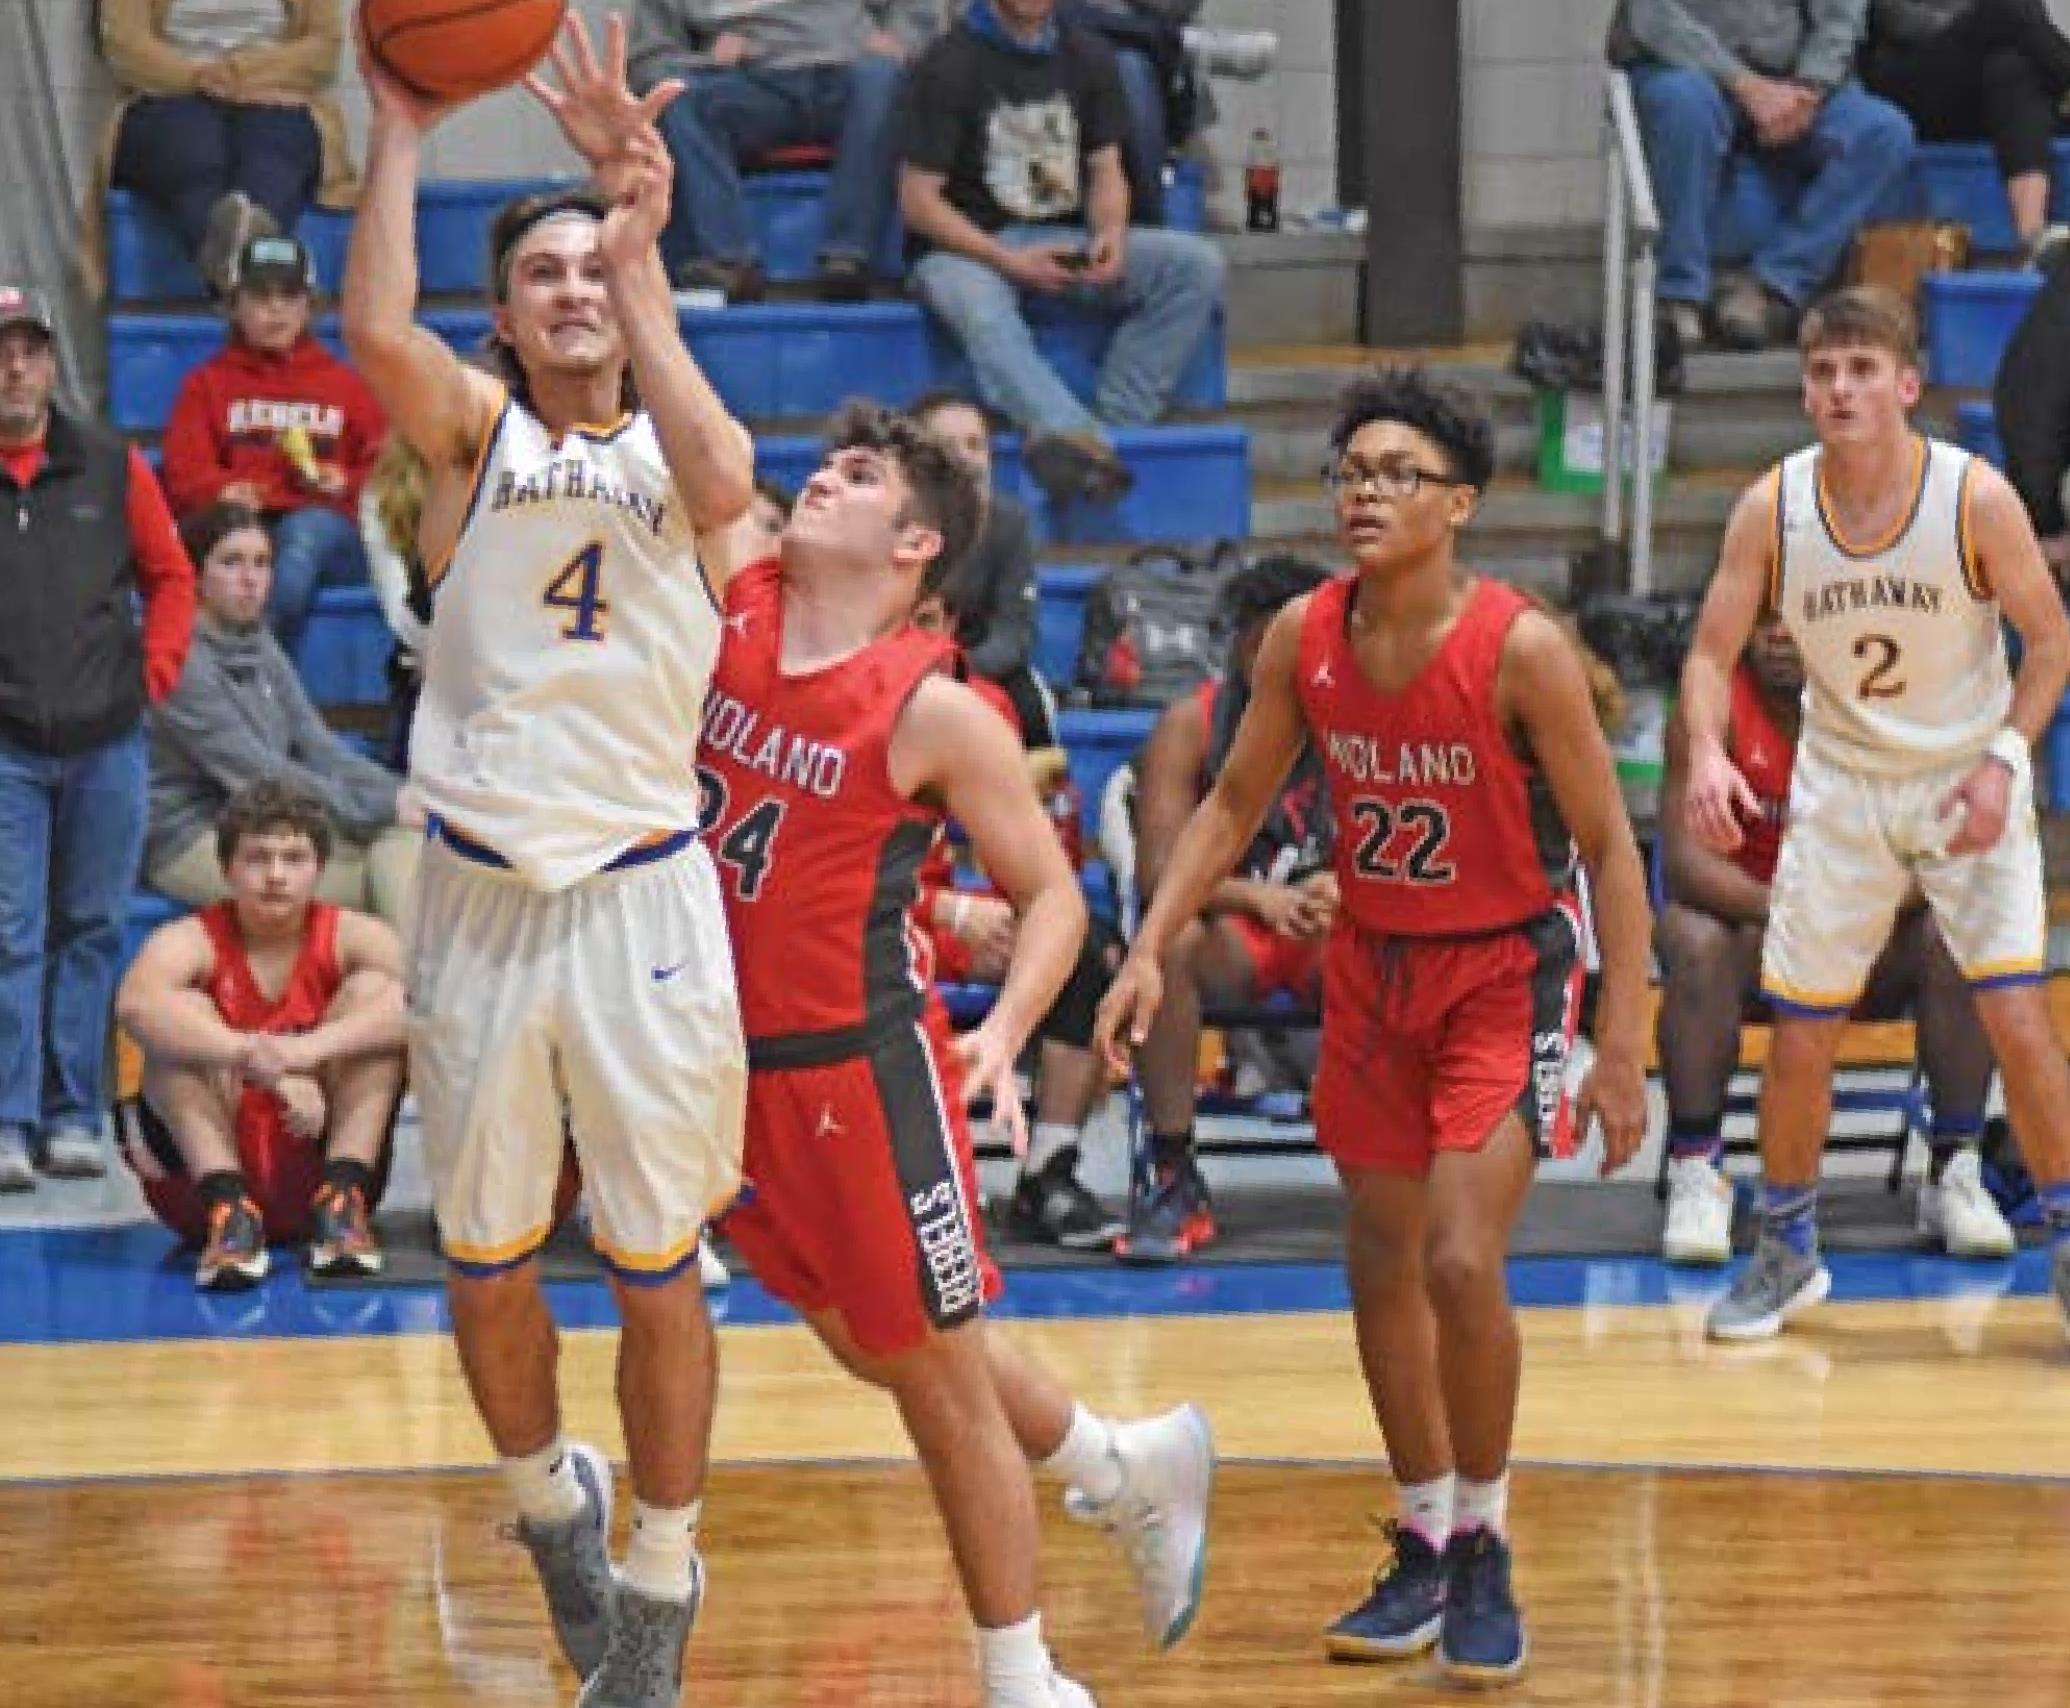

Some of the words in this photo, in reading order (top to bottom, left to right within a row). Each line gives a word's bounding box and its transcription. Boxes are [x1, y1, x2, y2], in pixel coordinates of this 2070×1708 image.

[542, 538, 609, 642] 4
[1803, 576, 1942, 622] HATHAWAY
[1852, 633, 1906, 699] 2
[1350, 793, 1456, 884] 22
